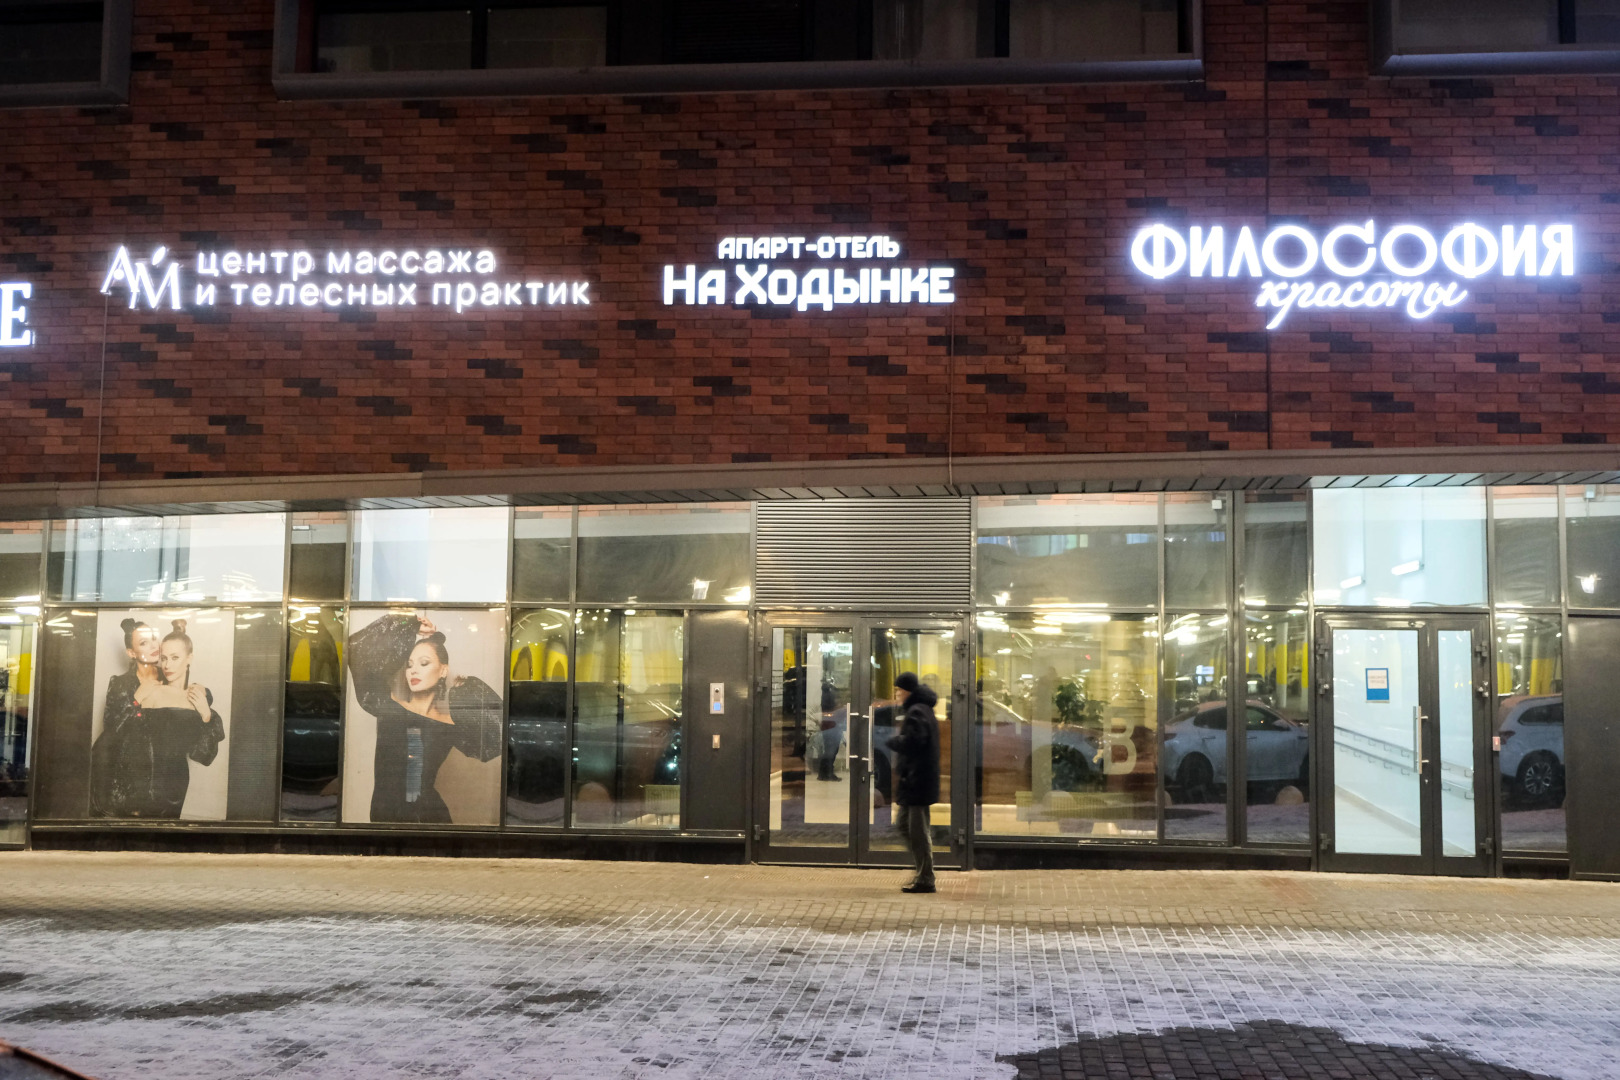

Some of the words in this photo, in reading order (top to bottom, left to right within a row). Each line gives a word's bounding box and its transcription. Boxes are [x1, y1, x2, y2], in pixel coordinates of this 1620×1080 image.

[197, 250, 314, 277] центр
[327, 247, 496, 275] массажа
[718, 235, 900, 260] АПАРТ-ОТЕЛЬ
[1130, 219, 1575, 279] ФИЛОСОФИЯ
[195, 282, 217, 306] и
[230, 278, 417, 306] телесных
[432, 280, 590, 314] практик
[663, 264, 726, 305] НА
[735, 264, 955, 312] ХОДЫНКЕ
[1256, 280, 1470, 330] красоты
